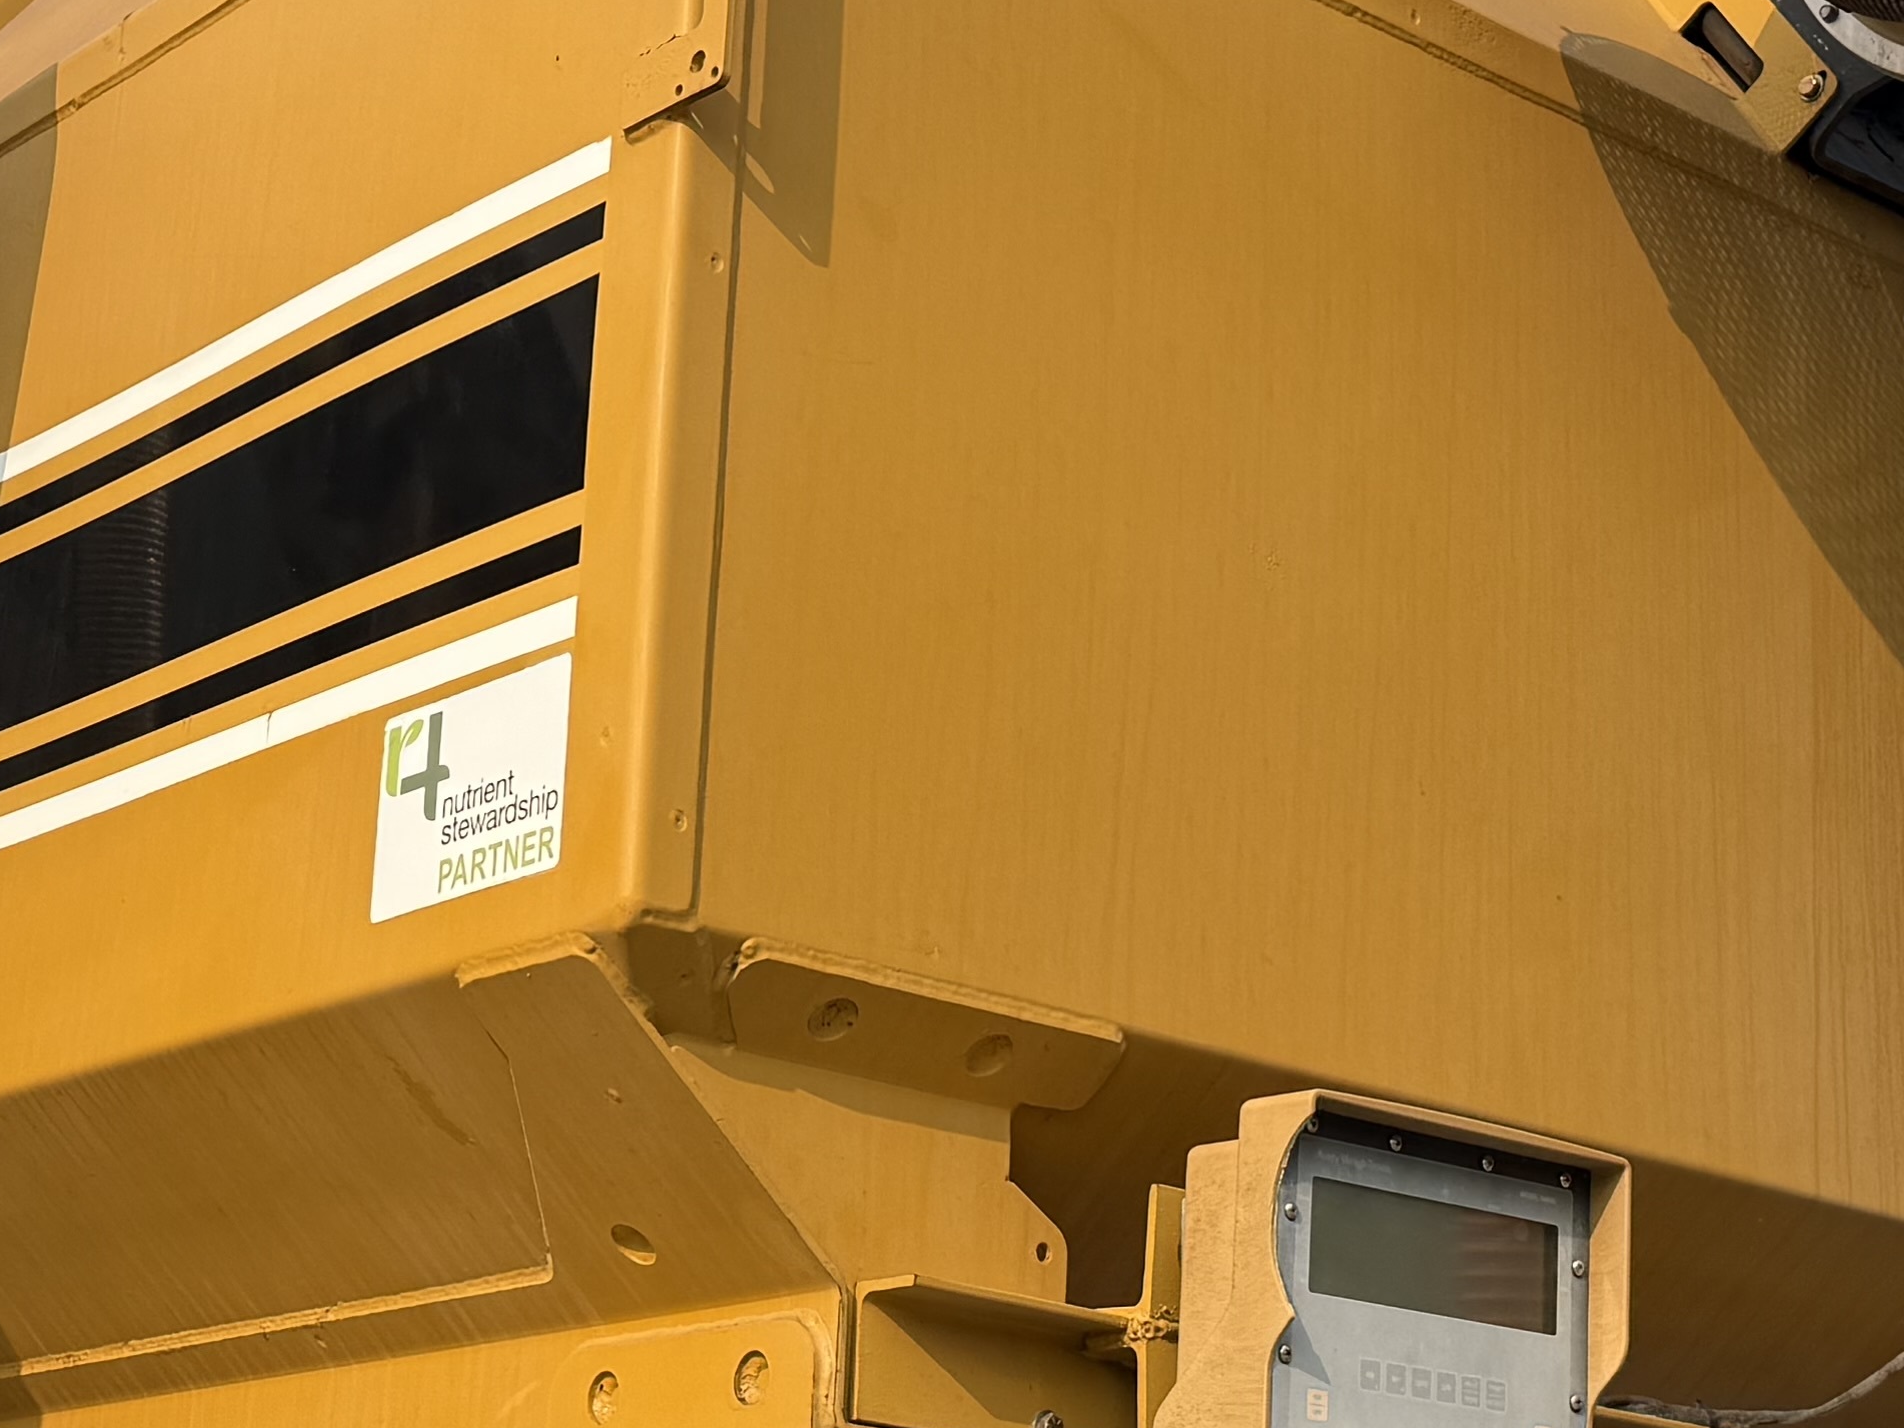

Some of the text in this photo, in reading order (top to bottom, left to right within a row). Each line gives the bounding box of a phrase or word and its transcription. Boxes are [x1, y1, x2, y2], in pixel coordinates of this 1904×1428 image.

[441, 785, 559, 846] stewardship
[442, 769, 515, 818] nutrient
[437, 826, 555, 893] PARTNER
